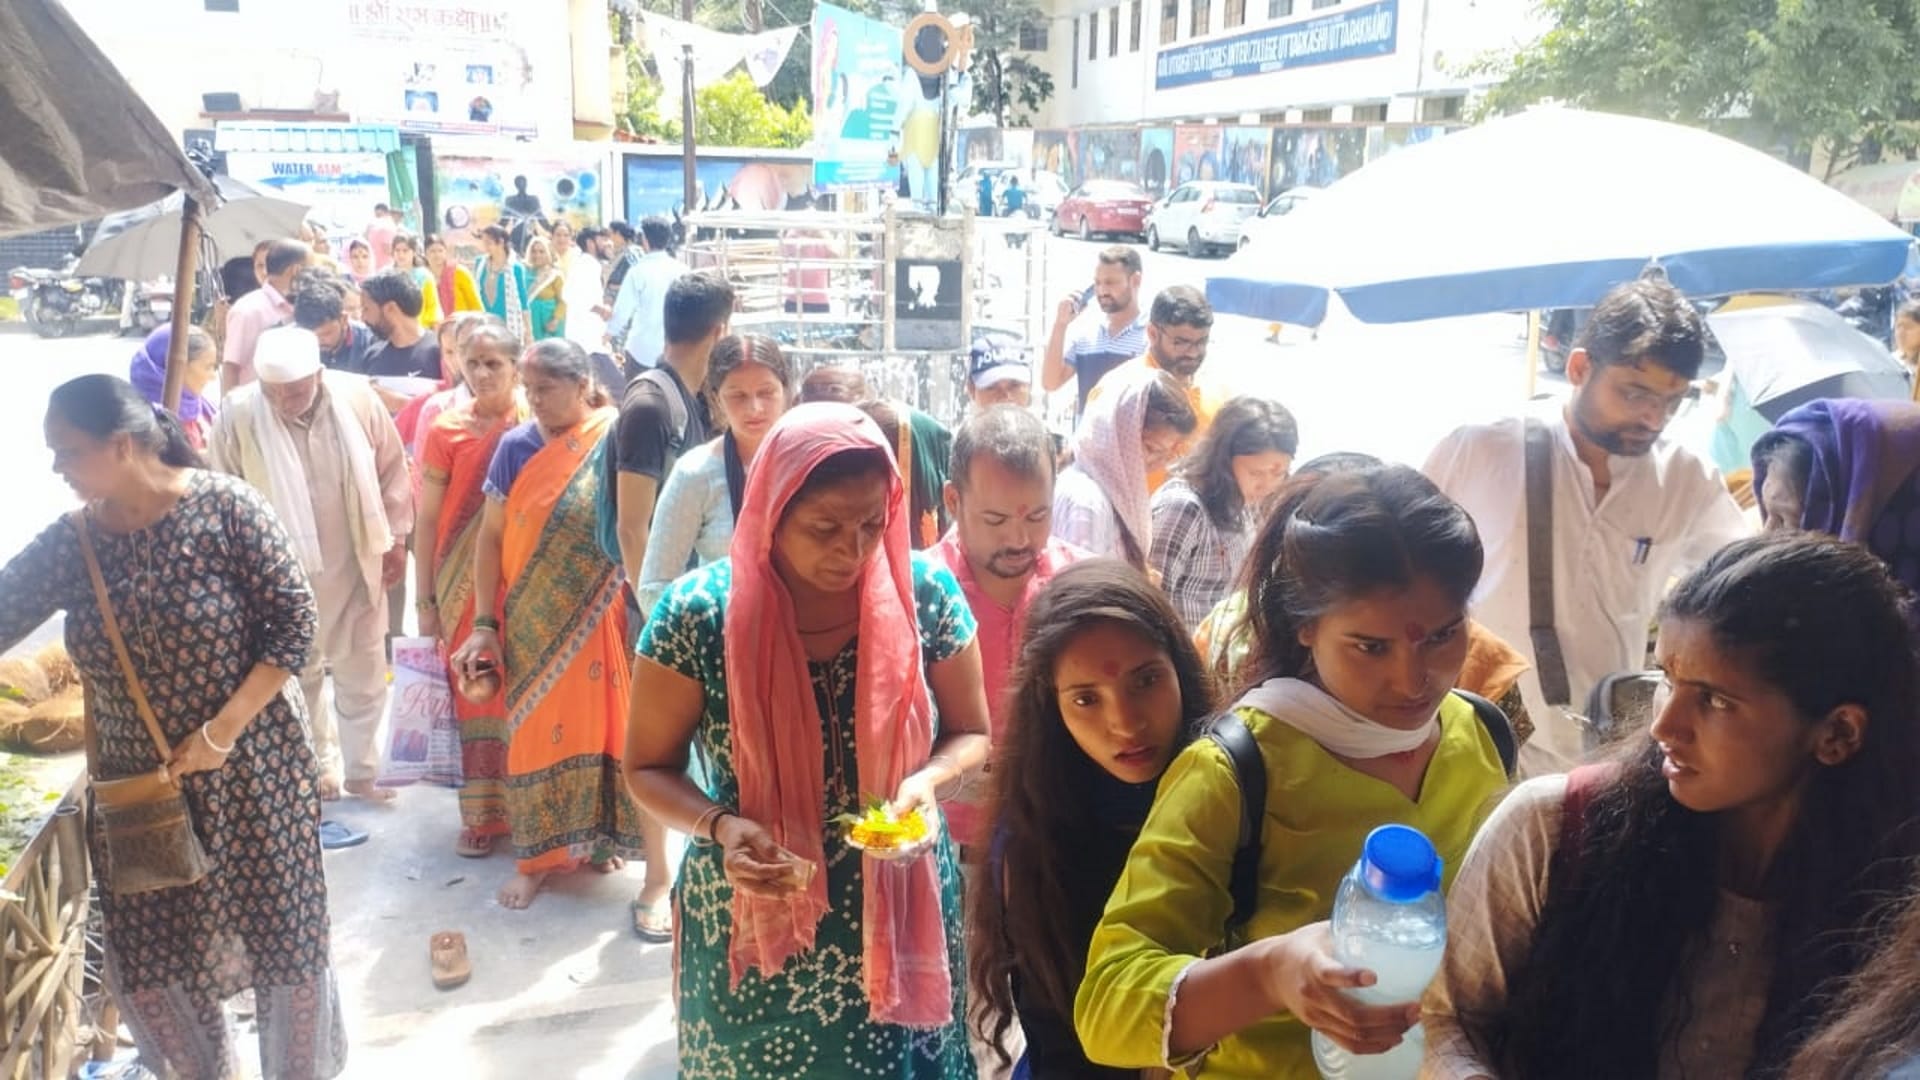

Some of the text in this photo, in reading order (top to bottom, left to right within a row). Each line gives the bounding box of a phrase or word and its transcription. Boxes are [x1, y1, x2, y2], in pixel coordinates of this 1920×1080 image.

[1228, 41, 1249, 66] INTER
[1279, 25, 1327, 59] UTTARKASHI
[272, 162, 341, 175] WATER ATM
